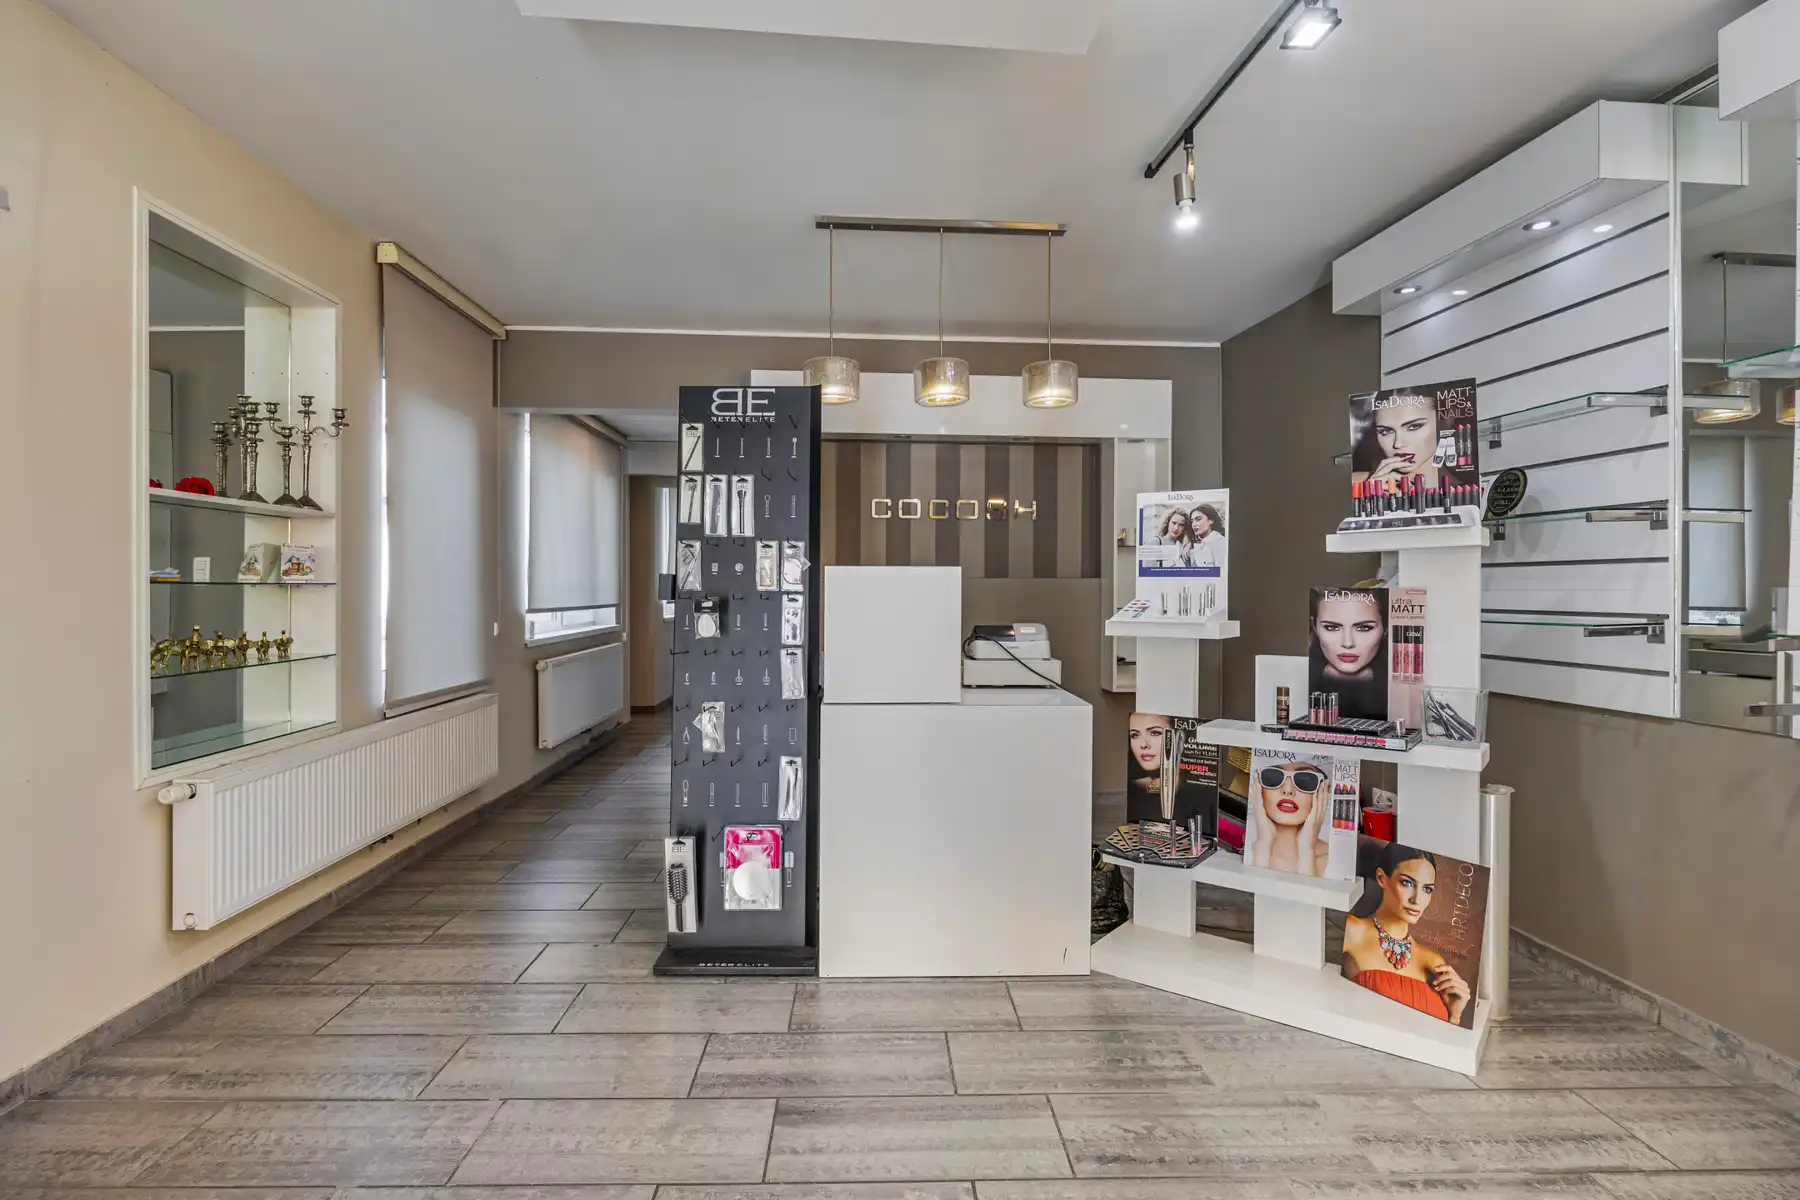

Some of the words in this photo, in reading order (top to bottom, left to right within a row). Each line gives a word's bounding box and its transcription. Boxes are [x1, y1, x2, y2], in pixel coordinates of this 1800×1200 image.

[1438, 407, 1475, 421] NAILS
[871, 498, 1037, 521] COCOSH
[1391, 604, 1425, 614] MATT
[1183, 743, 1218, 752] VOLUME
[1179, 763, 1209, 773] SUPER
[1334, 764, 1359, 775] MATT
[1333, 773, 1358, 783] LIPS
[1451, 863, 1474, 940] ARTDECO
